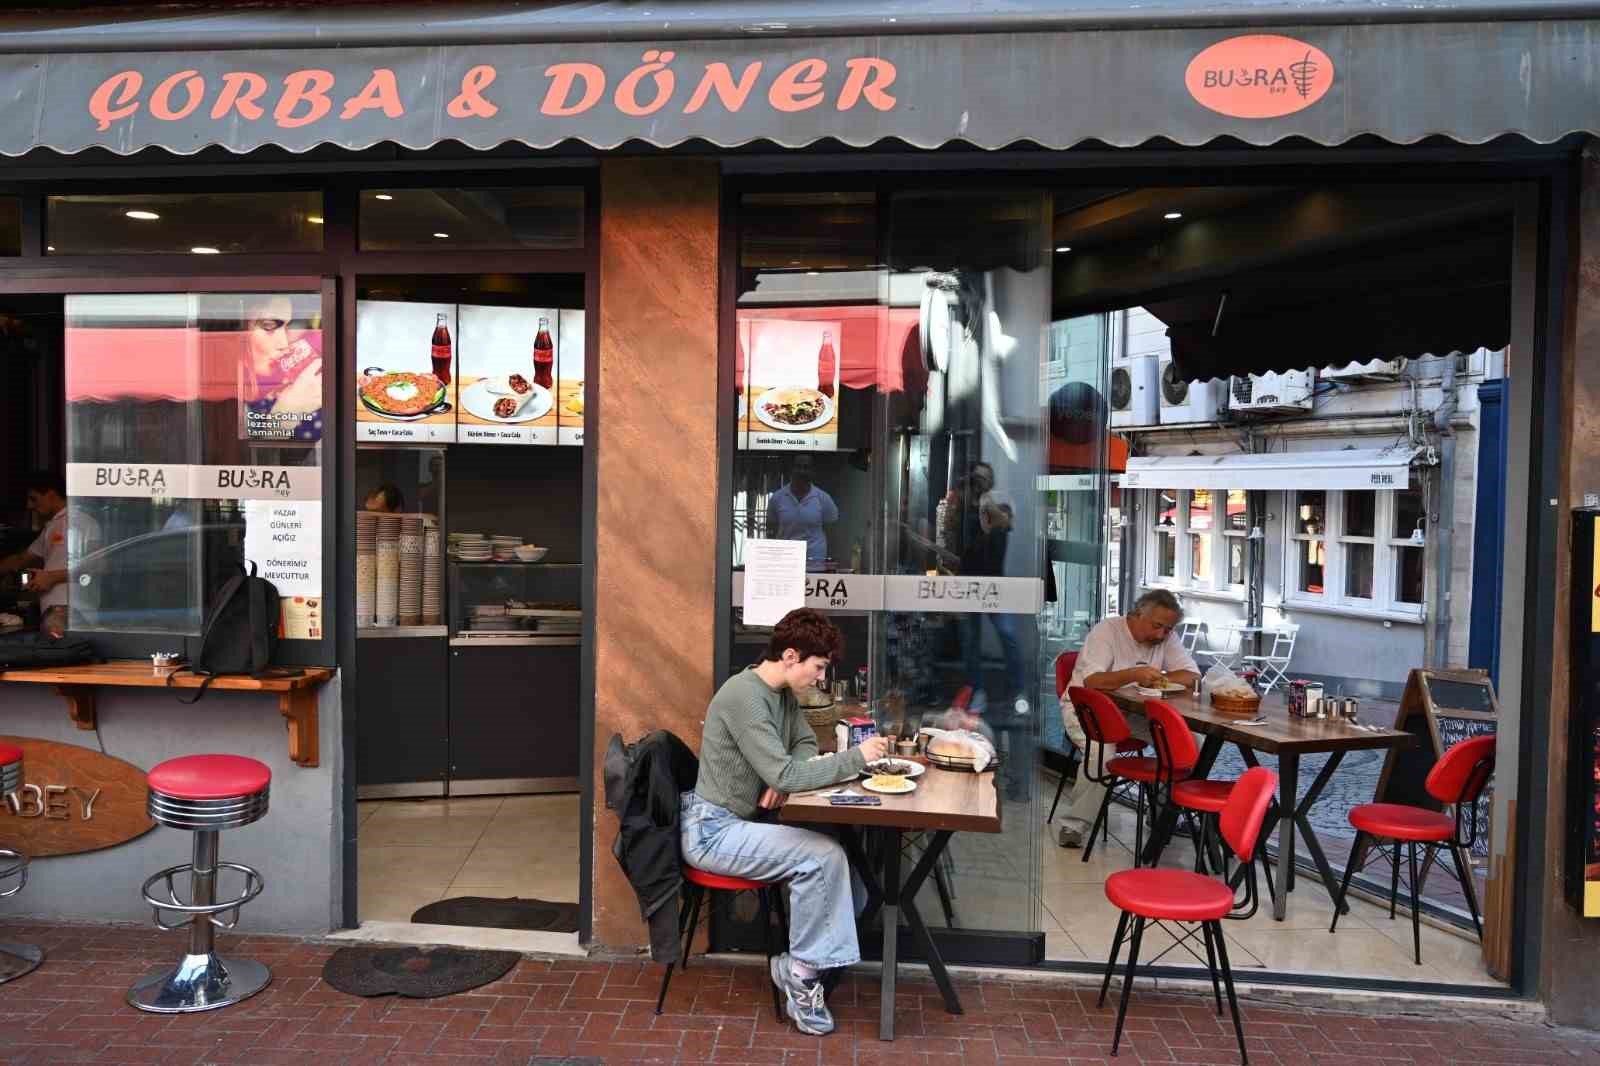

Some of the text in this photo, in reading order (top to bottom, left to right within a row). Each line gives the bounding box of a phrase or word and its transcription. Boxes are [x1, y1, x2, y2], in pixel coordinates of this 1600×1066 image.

[88, 49, 898, 132] ÇORBA & DÖNER
[247, 411, 313, 421] Coca-Cola ile
[247, 419, 280, 428] lezzeti
[273, 509, 296, 517] PAZAR
[264, 571, 310, 580] MEVCUTTUR
